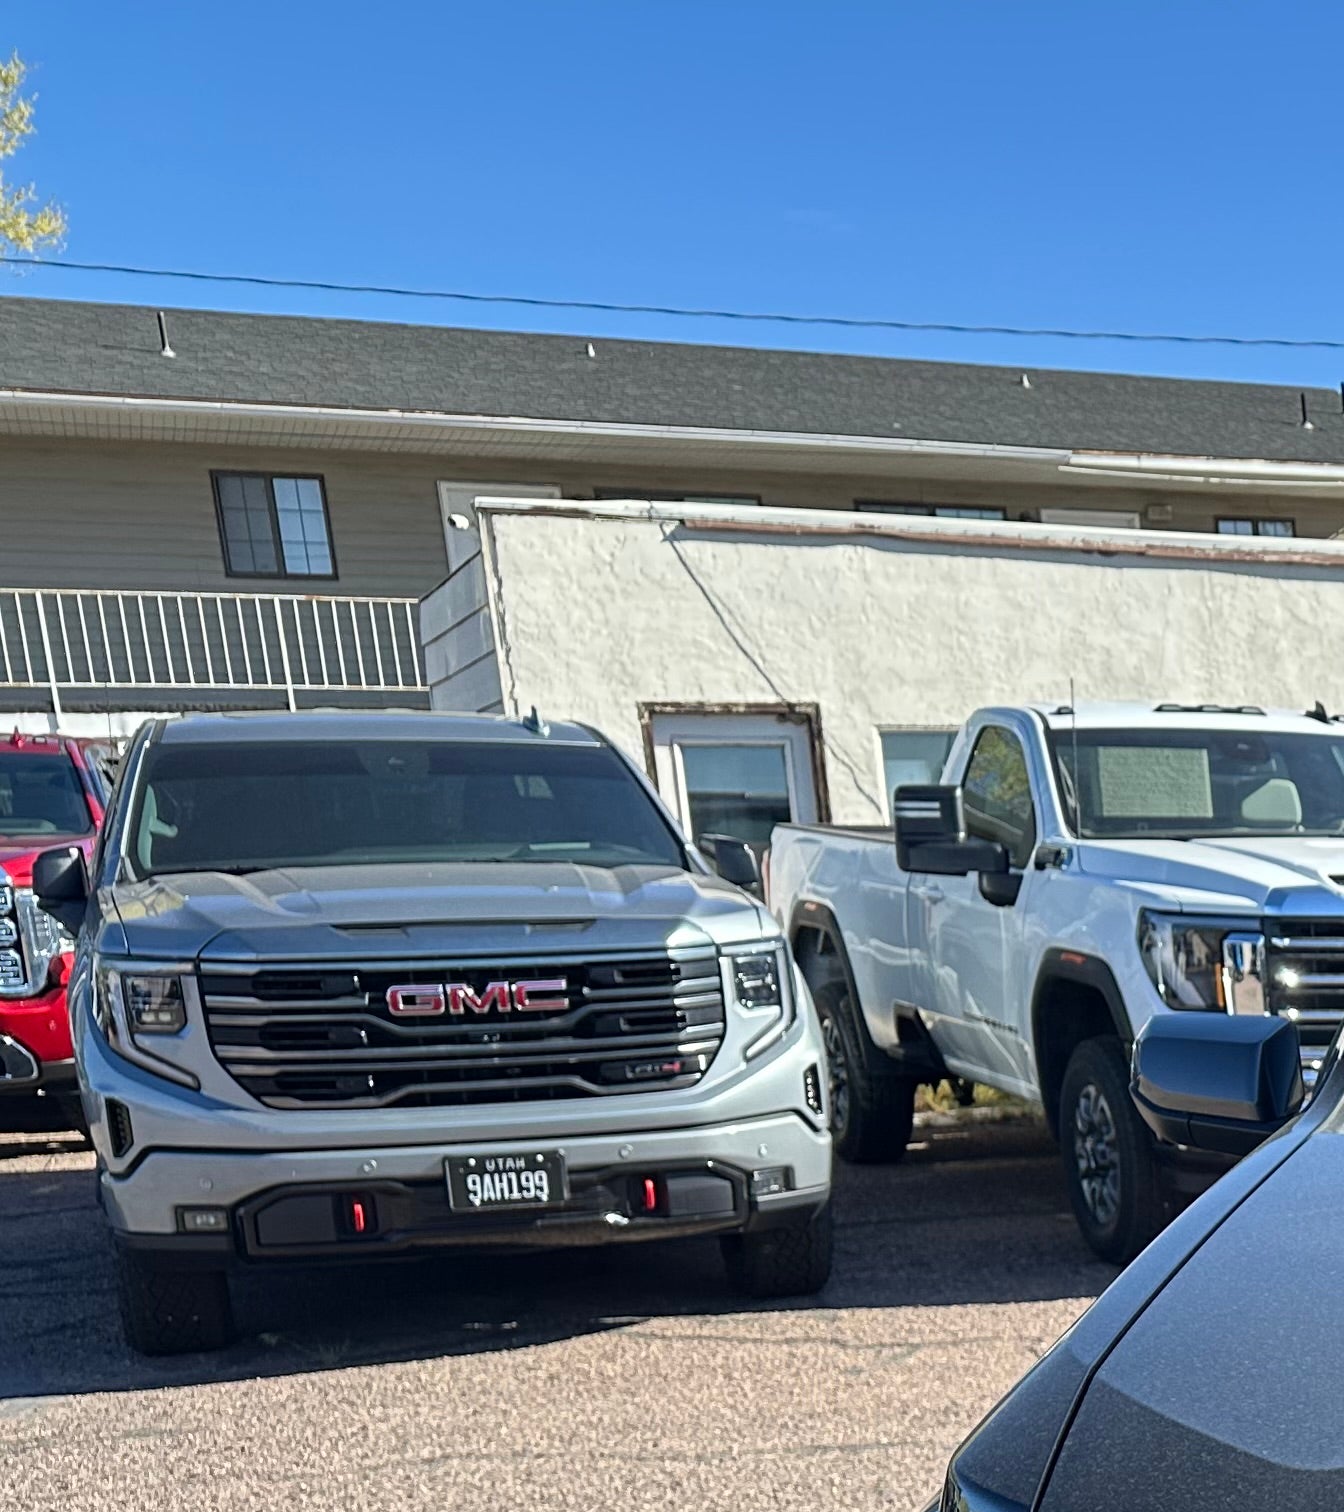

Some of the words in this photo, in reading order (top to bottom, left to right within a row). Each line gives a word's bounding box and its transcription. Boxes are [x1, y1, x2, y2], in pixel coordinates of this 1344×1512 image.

[386, 977, 570, 1017] GMC
[485, 1157, 526, 1171] UTAH
[466, 1170, 549, 1206] 9AH199
